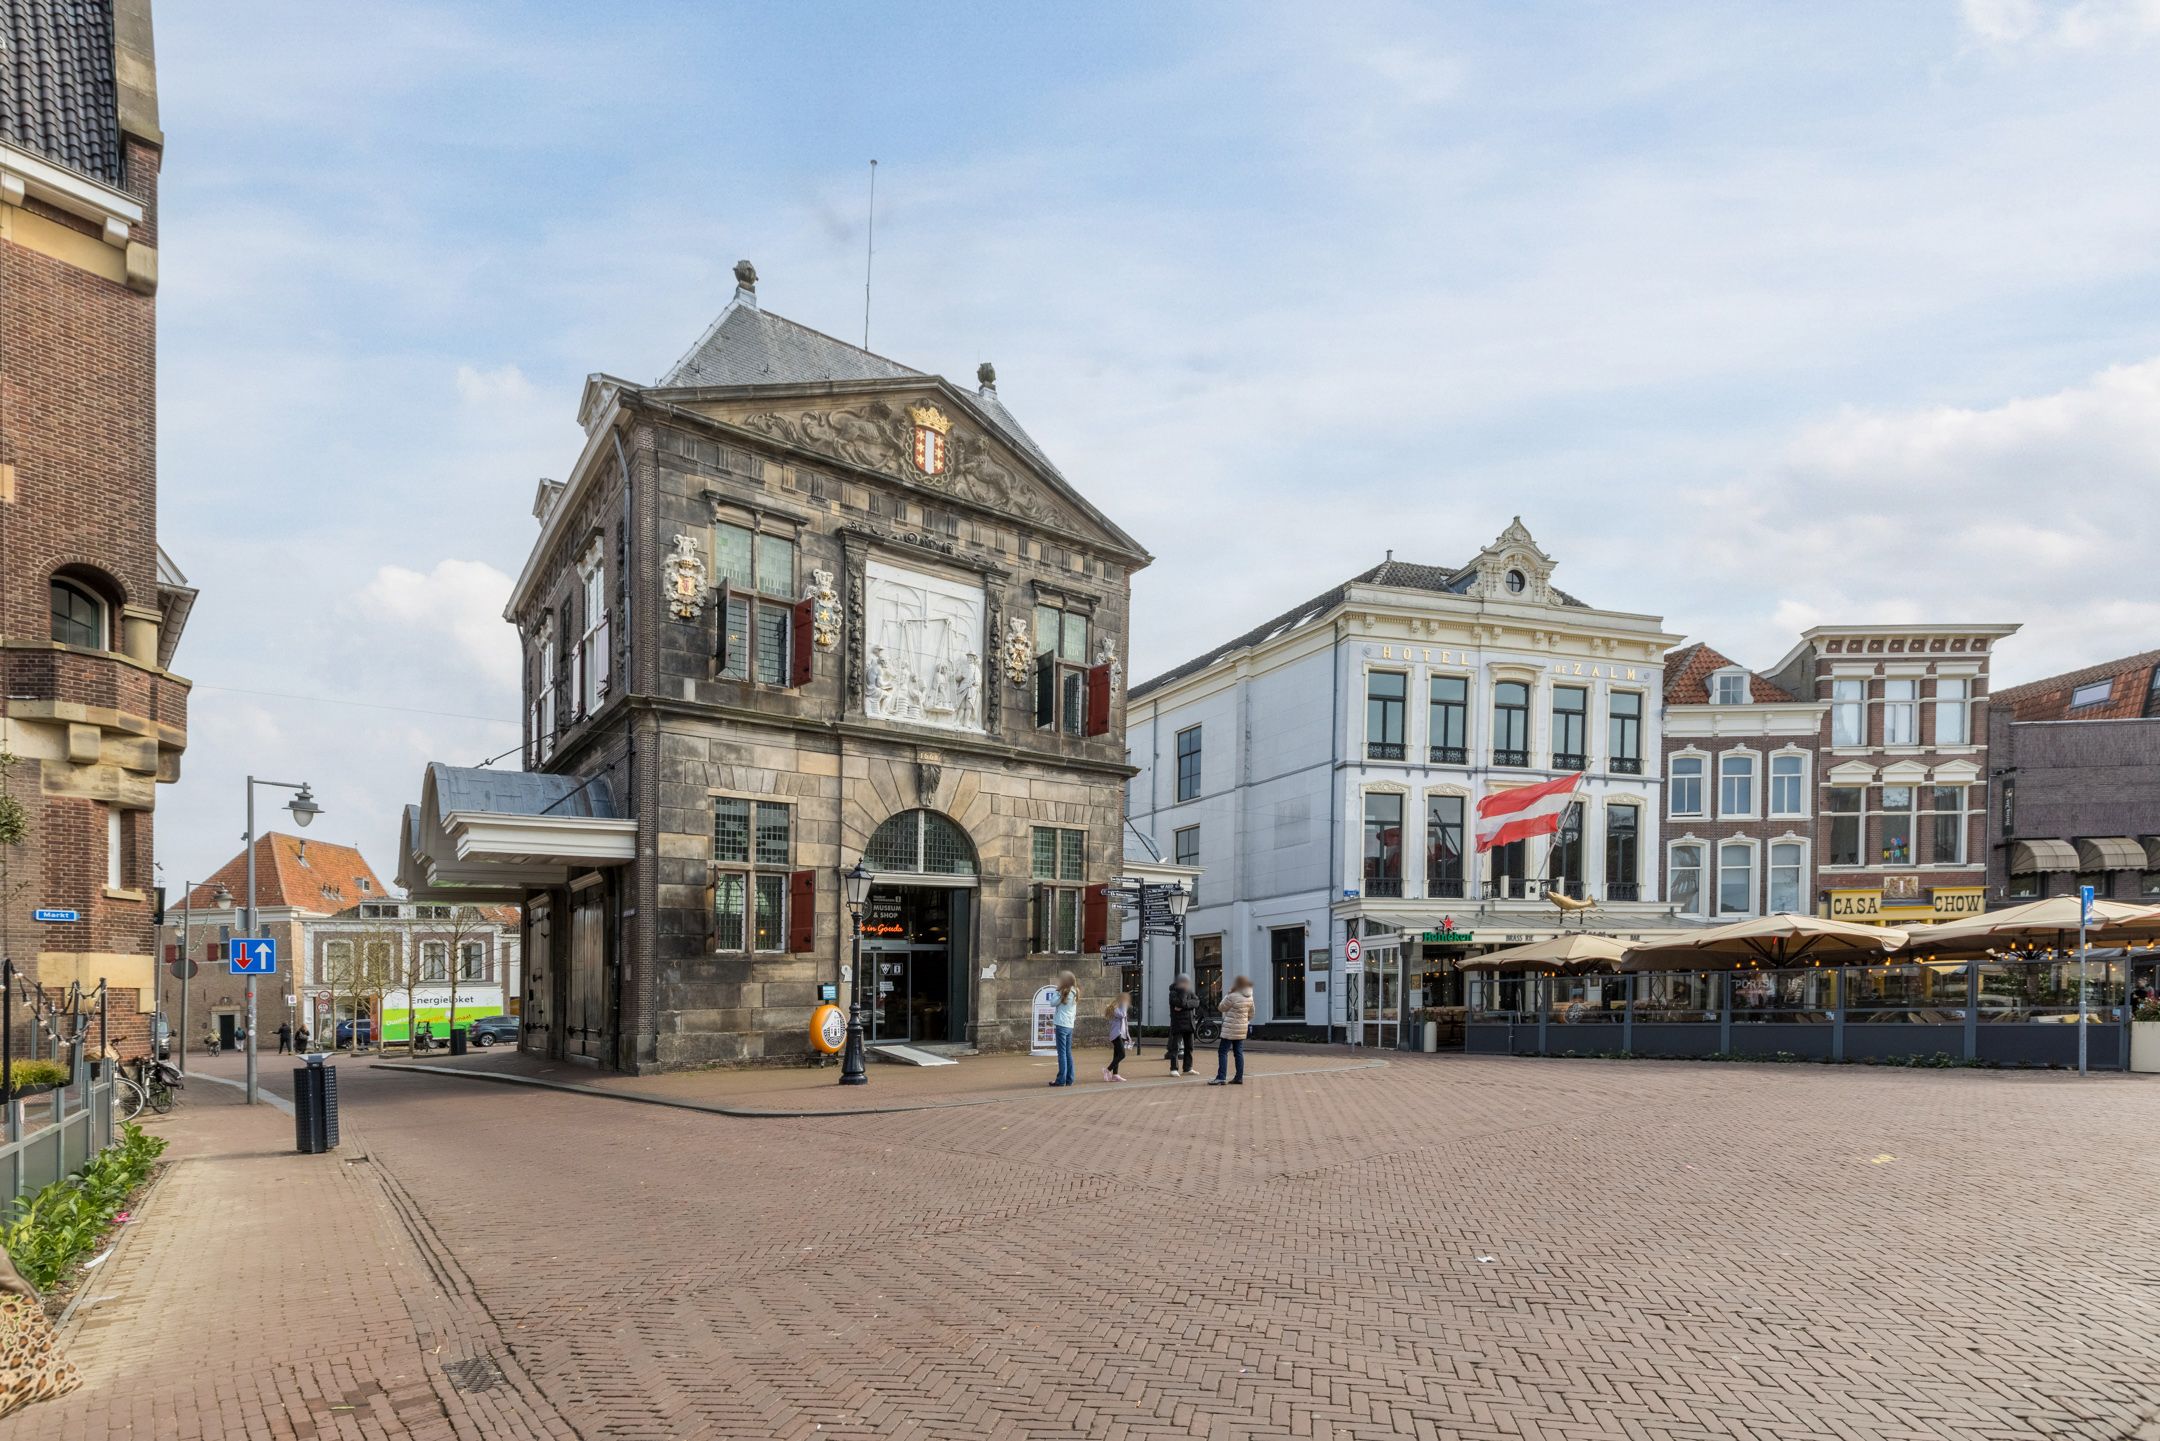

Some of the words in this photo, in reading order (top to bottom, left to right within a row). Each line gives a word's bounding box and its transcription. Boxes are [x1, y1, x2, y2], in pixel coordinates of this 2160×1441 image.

[1382, 645, 1469, 665] HOTEL
[1555, 663, 1567, 674] DE
[1573, 663, 1637, 681] ZALM
[1833, 897, 1879, 915] CASA
[1934, 895, 1982, 913] CHOW
[877, 924, 903, 935] Gouda
[1422, 932, 1473, 942] Heineken
